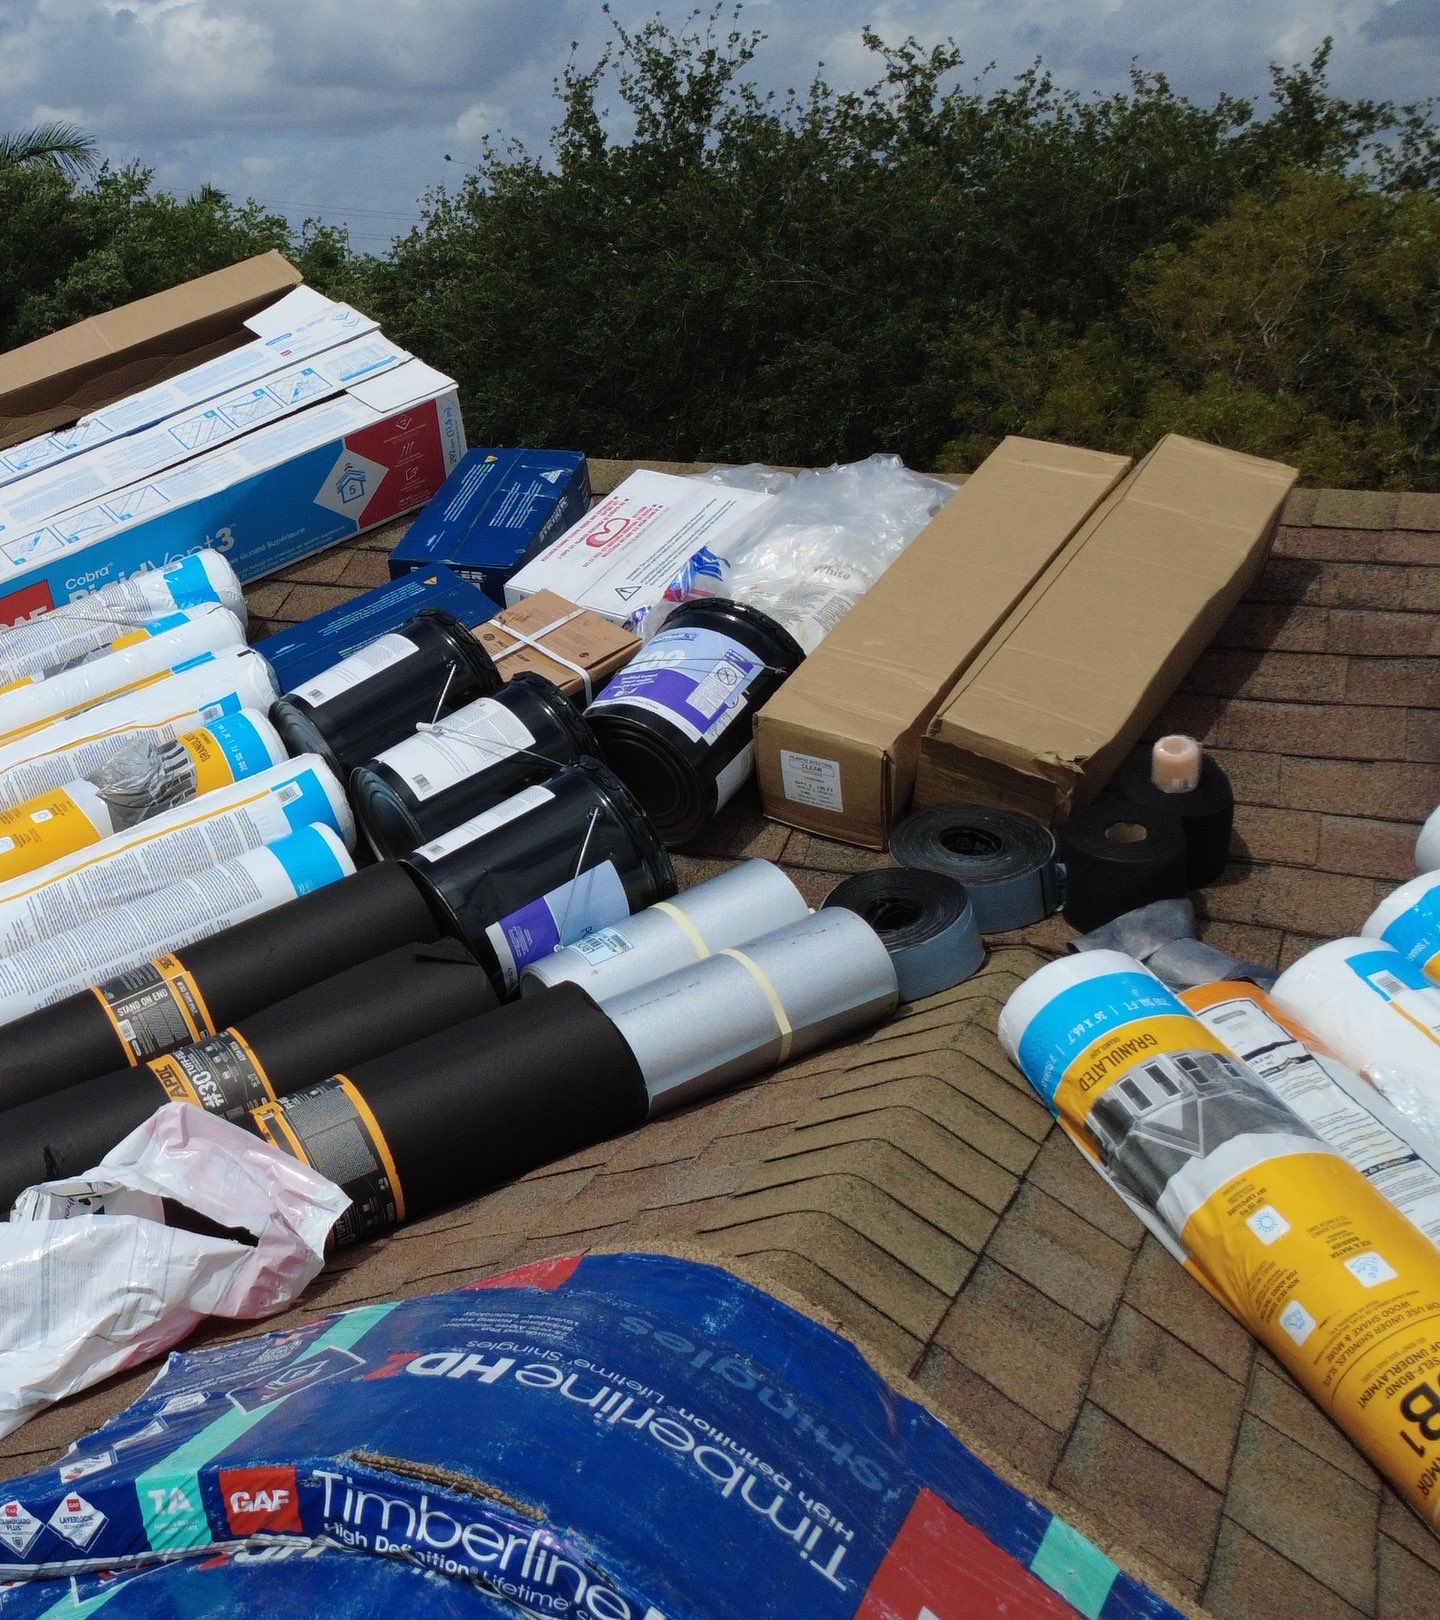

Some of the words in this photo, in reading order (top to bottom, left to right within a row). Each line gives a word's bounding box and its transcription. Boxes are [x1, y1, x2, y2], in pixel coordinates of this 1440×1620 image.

[64, 566, 110, 590] Cobra
[117, 1000, 141, 1017] STAND
[141, 995, 153, 1006] ON
[152, 988, 168, 1000] END
[1078, 1033, 1158, 1092] GRANULATED
[156, 1063, 189, 1099] APOC
[192, 1070, 225, 1108] #30
[1381, 1301, 1411, 1318] WOOD
[1406, 1305, 1424, 1319] USE
[1353, 1314, 1381, 1337] SHAKE
[1374, 1313, 1405, 1336] UNDER
[466, 1339, 563, 1362] Shingles
[1326, 1341, 1345, 1364] MORE
[1358, 1349, 1428, 1409] UNDERLAYMENT
[620, 1315, 889, 1491] Shingles
[148, 1487, 193, 1514] TA
[230, 1488, 291, 1514] GAF
[798, 1490, 855, 1541] High
[312, 1469, 631, 1620] Timberline
[324, 1522, 368, 1548] High
